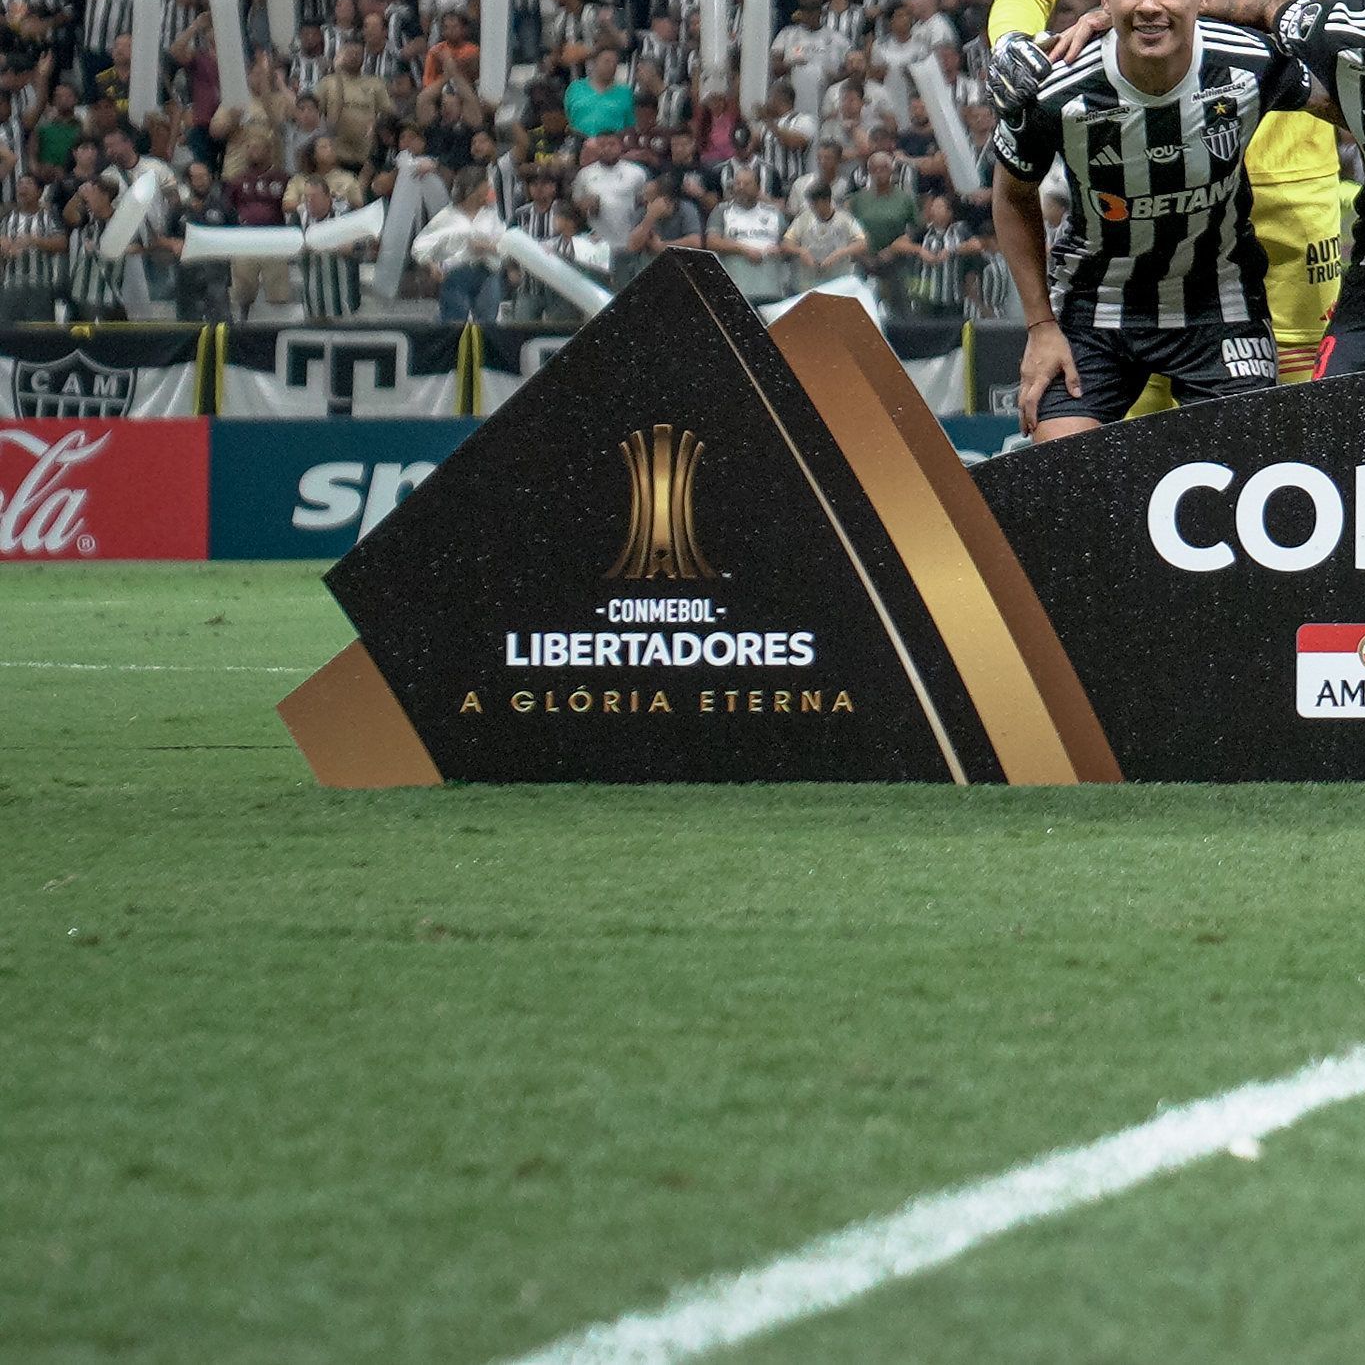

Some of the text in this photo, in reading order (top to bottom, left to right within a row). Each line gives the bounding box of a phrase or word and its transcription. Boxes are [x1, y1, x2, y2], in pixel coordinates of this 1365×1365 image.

[1206, 119, 1241, 136] CAM
[29, 370, 119, 397] CAM
[505, 631, 815, 667] LIBERTADORES
[459, 685, 855, 714] A GLÓRIA ETERNA
